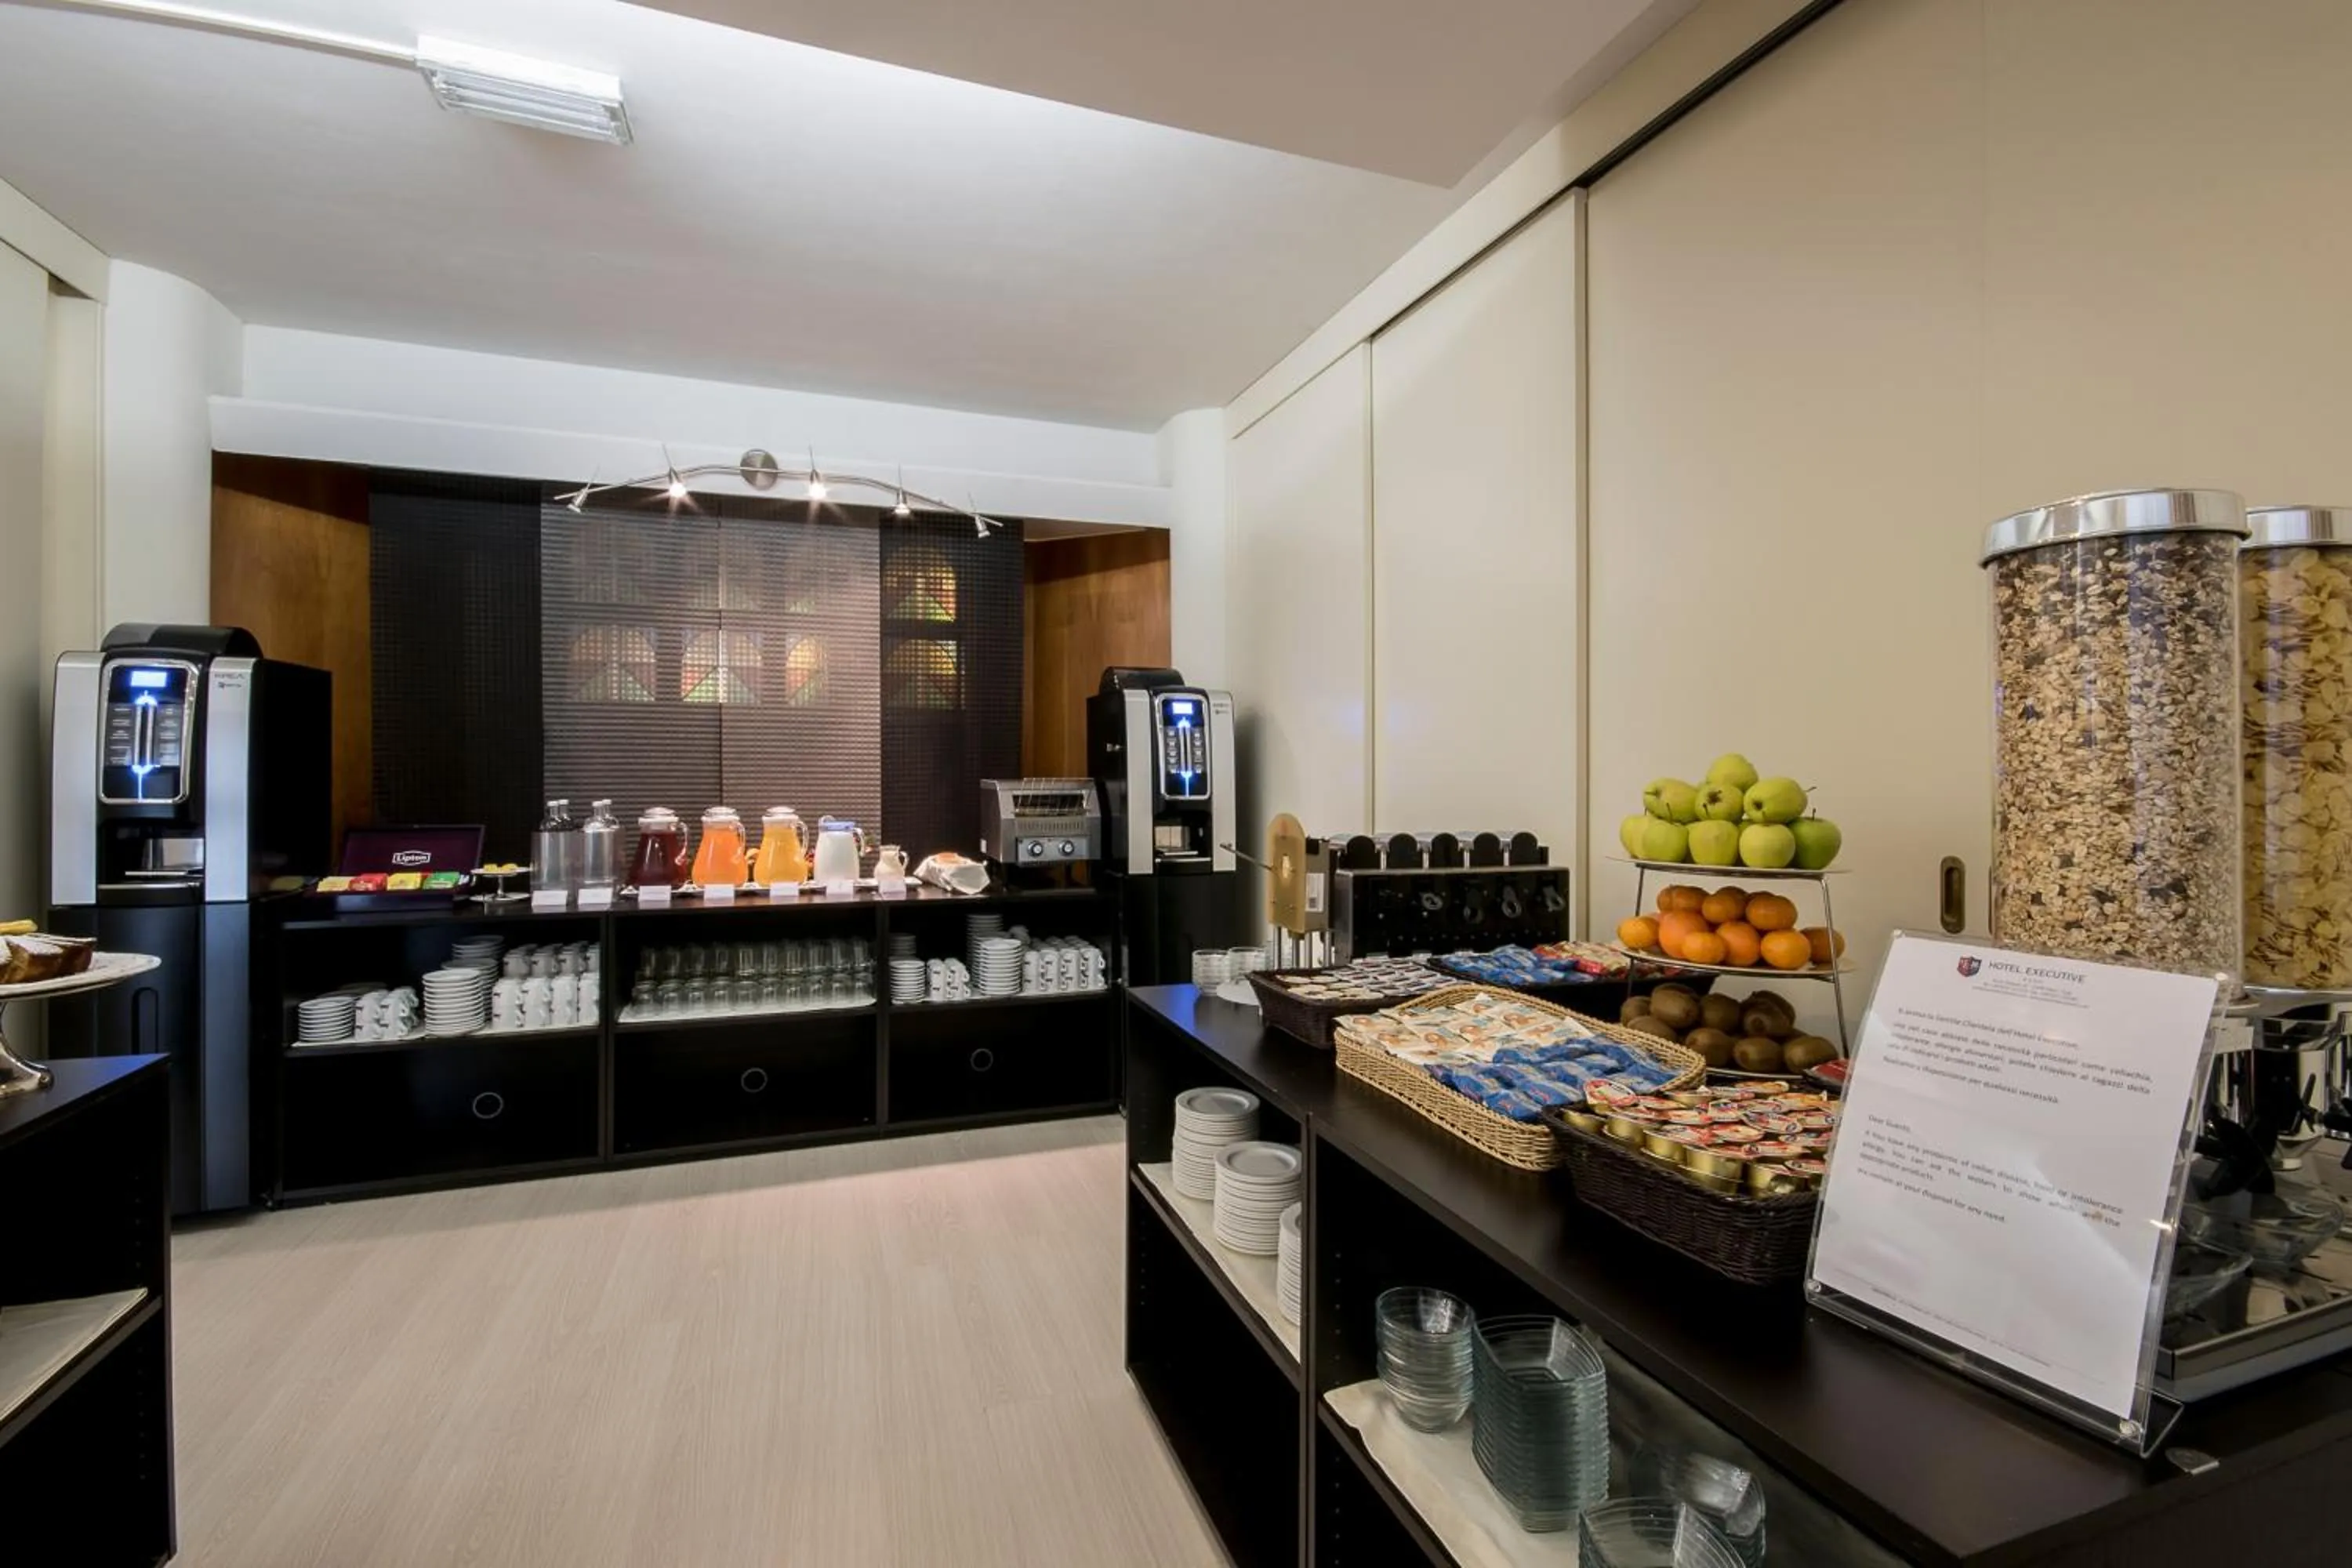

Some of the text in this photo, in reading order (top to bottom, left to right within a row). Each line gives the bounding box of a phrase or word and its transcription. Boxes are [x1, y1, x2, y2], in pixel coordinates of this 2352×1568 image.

[397, 854, 427, 862] Lipton
[1987, 960, 2020, 972] HOTEL
[2025, 966, 2086, 982] EXECUTIVE
